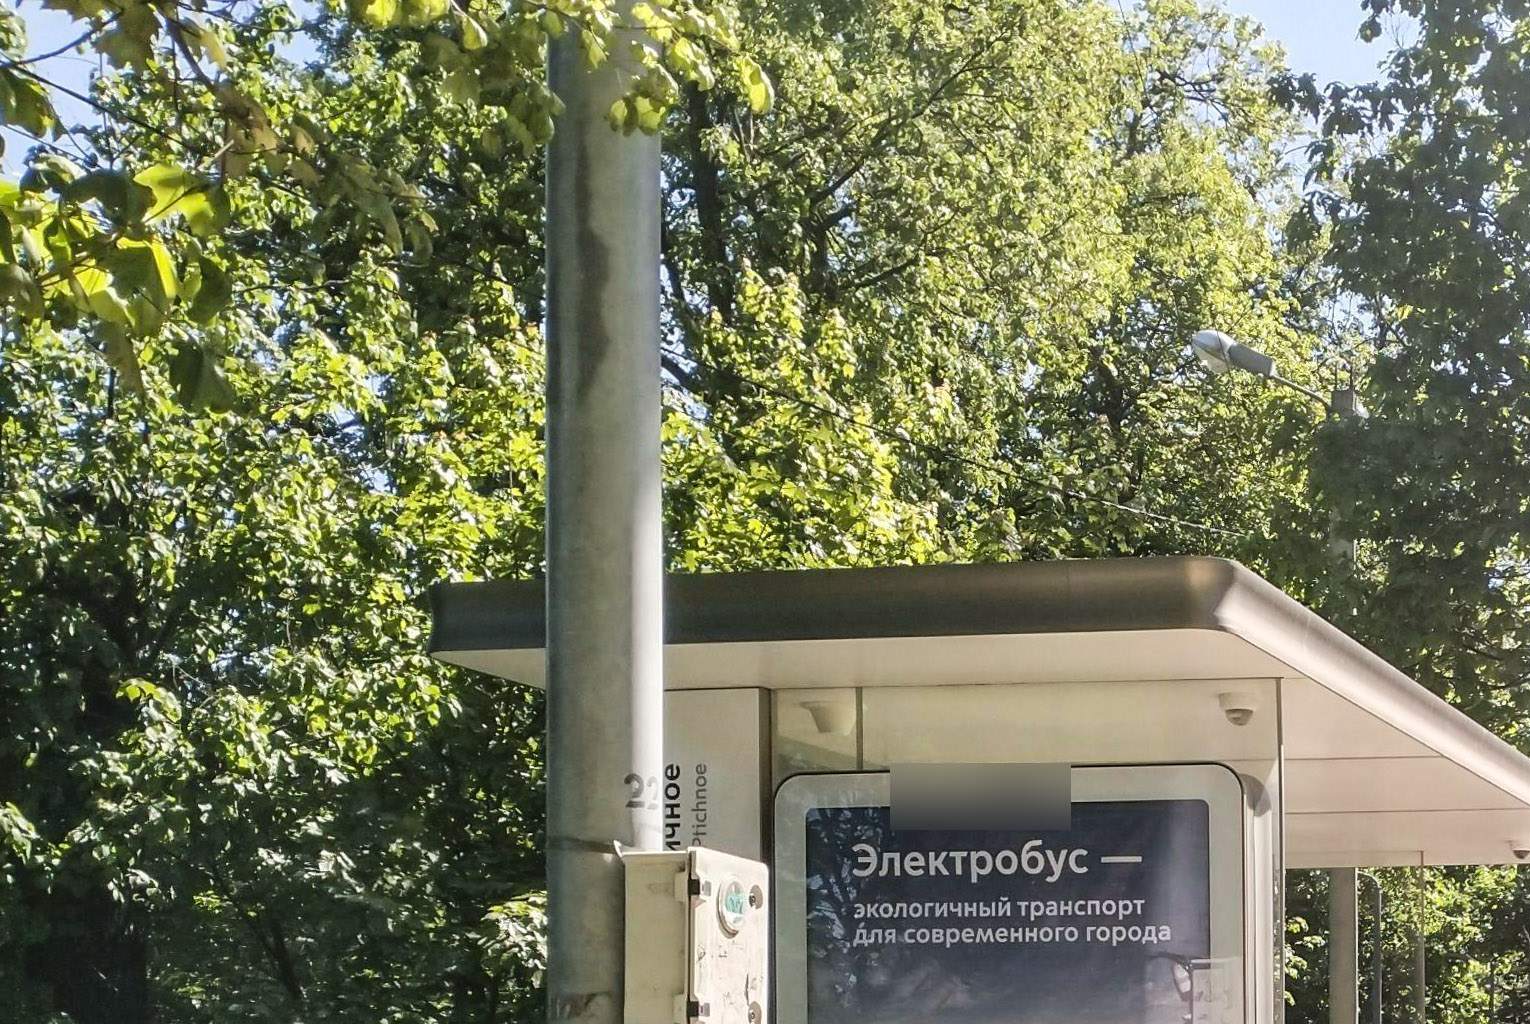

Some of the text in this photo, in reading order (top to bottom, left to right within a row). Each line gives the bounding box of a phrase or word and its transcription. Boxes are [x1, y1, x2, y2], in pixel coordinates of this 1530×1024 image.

[851, 839, 1089, 883] Электробус
[852, 897, 1145, 921] экологичный транспорт
[853, 923, 1171, 948] для современного города
